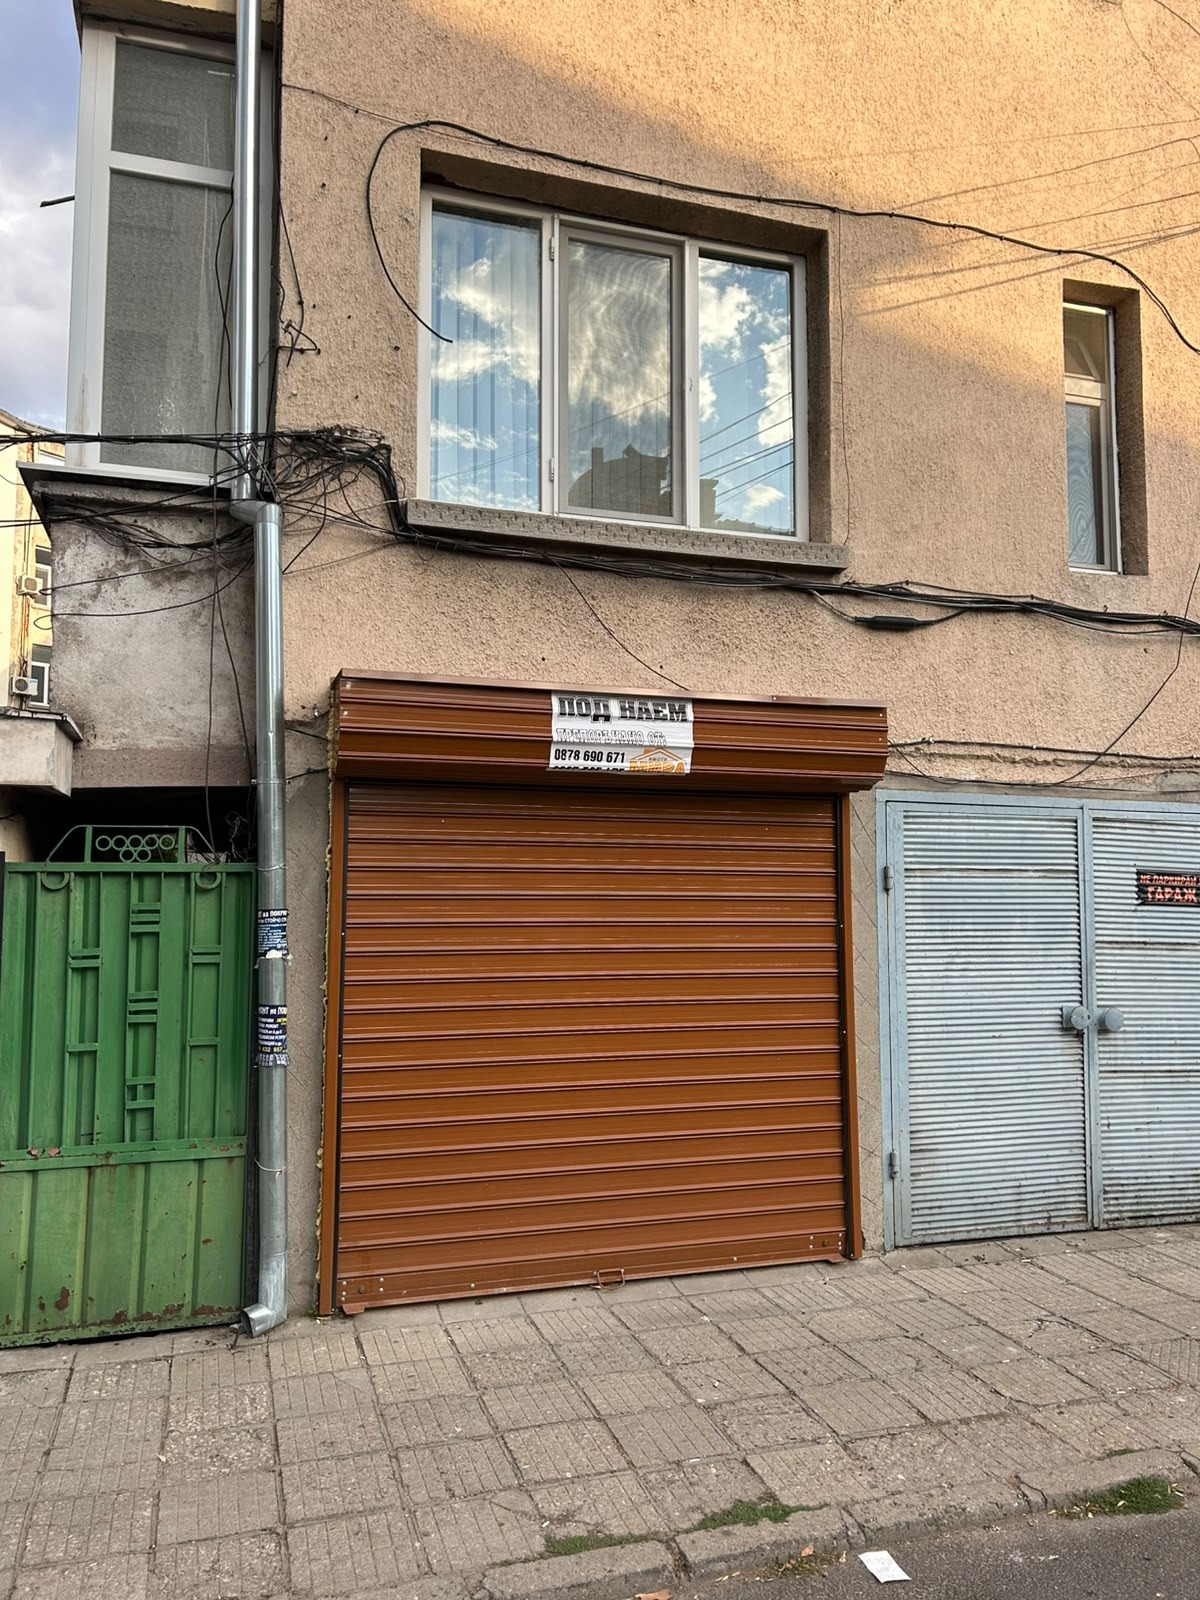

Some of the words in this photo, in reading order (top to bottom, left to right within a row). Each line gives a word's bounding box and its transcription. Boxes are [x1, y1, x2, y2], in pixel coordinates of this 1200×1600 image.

[558, 697, 611, 723] ПОД
[618, 700, 688, 722] НАЕМ
[554, 749, 580, 761] 0878
[583, 750, 603, 762] 690
[606, 751, 625, 763] 671
[1140, 874, 1151, 884] НЕ
[1147, 886, 1197, 902] ГАРАЖ
